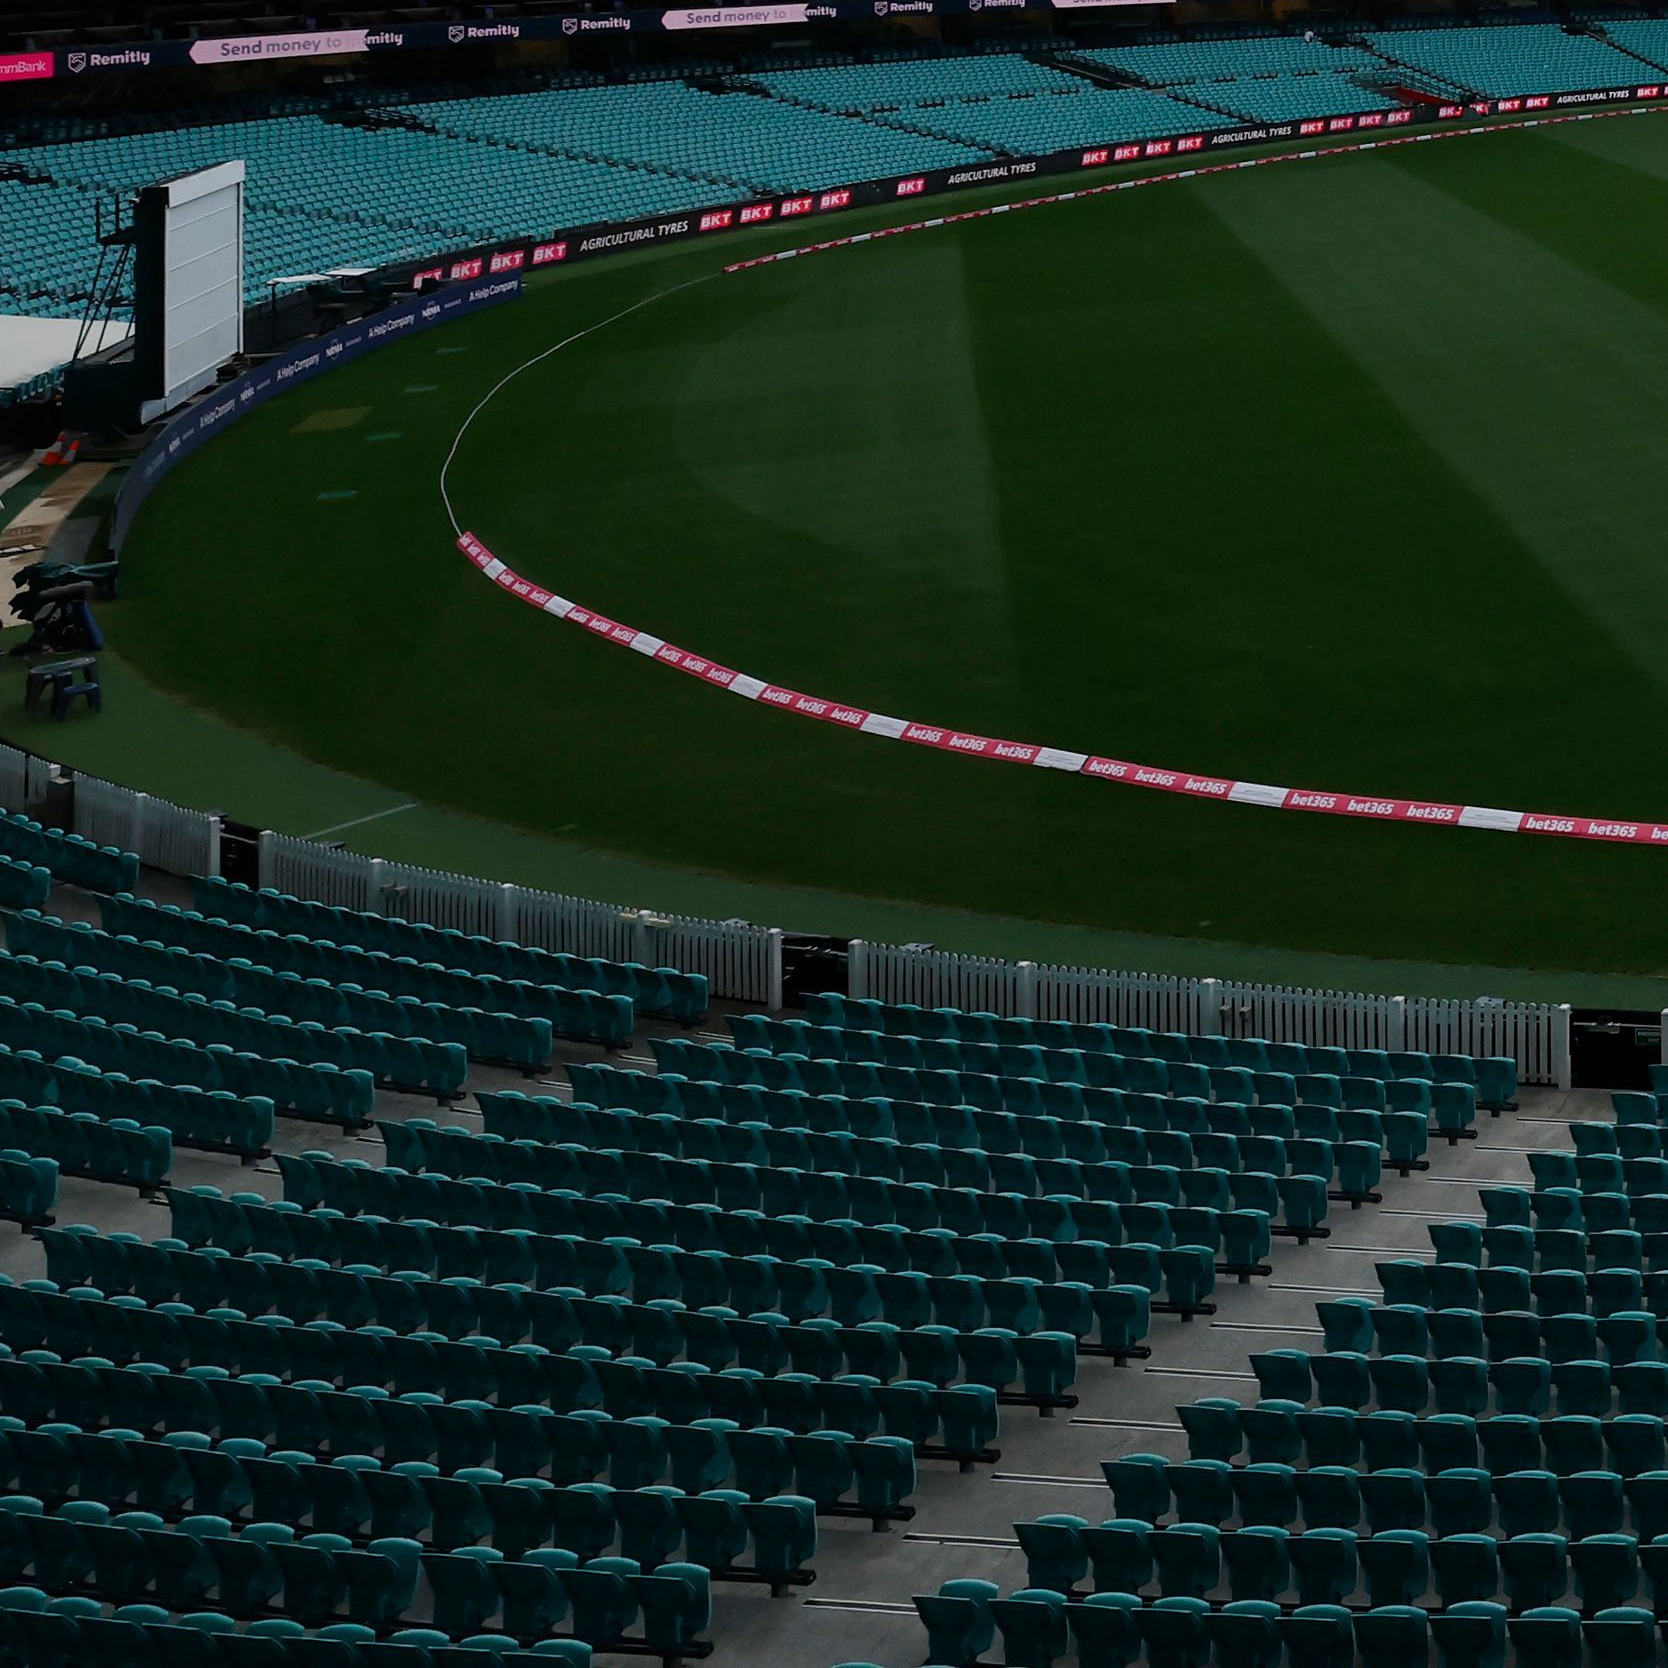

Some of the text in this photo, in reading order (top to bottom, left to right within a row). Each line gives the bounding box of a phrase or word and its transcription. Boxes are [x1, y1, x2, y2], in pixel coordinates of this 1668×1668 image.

[890, 1, 933, 13] Remitly
[580, 17, 630, 30] Remitly
[686, 10, 770, 24] Send money
[468, 24, 519, 38] Remitly
[221, 41, 261, 56] Send
[267, 37, 321, 52] money
[0, 60, 46, 74] mmBank
[90, 50, 150, 67] Remitly
[1557, 90, 1629, 104] AGRICULTURAL TYRES
[1637, 87, 1659, 98] BKT
[1527, 97, 1548, 108] BKT
[1300, 122, 1323, 134] BKT
[1359, 115, 1381, 127] BKT
[1178, 137, 1202, 150] BKT
[1211, 126, 1292, 144] AGRICULTURAL TYRES
[1082, 151, 1107, 164] BKT
[949, 163, 1036, 184] AGRICULTURAL TYRES
[898, 180, 924, 194] BKT
[820, 192, 849, 208] BKT
[701, 212, 731, 230] BKT
[740, 206, 772, 223] BKT
[580, 220, 688, 251] AGRICULTURAL TYRES
[533, 244, 566, 261] BKT
[451, 261, 481, 279] BKT
[490, 280, 518, 295] Company
[830, 706, 862, 725] bet365
[906, 724, 942, 744] bet365
[994, 742, 1033, 760] bet365
[1089, 759, 1126, 778] bet365
[1184, 777, 1227, 795] bet365
[1290, 792, 1335, 809] bet365
[1406, 805, 1454, 821] bet365
[1526, 816, 1575, 833] bet365
[1587, 821, 1638, 839] bet365
